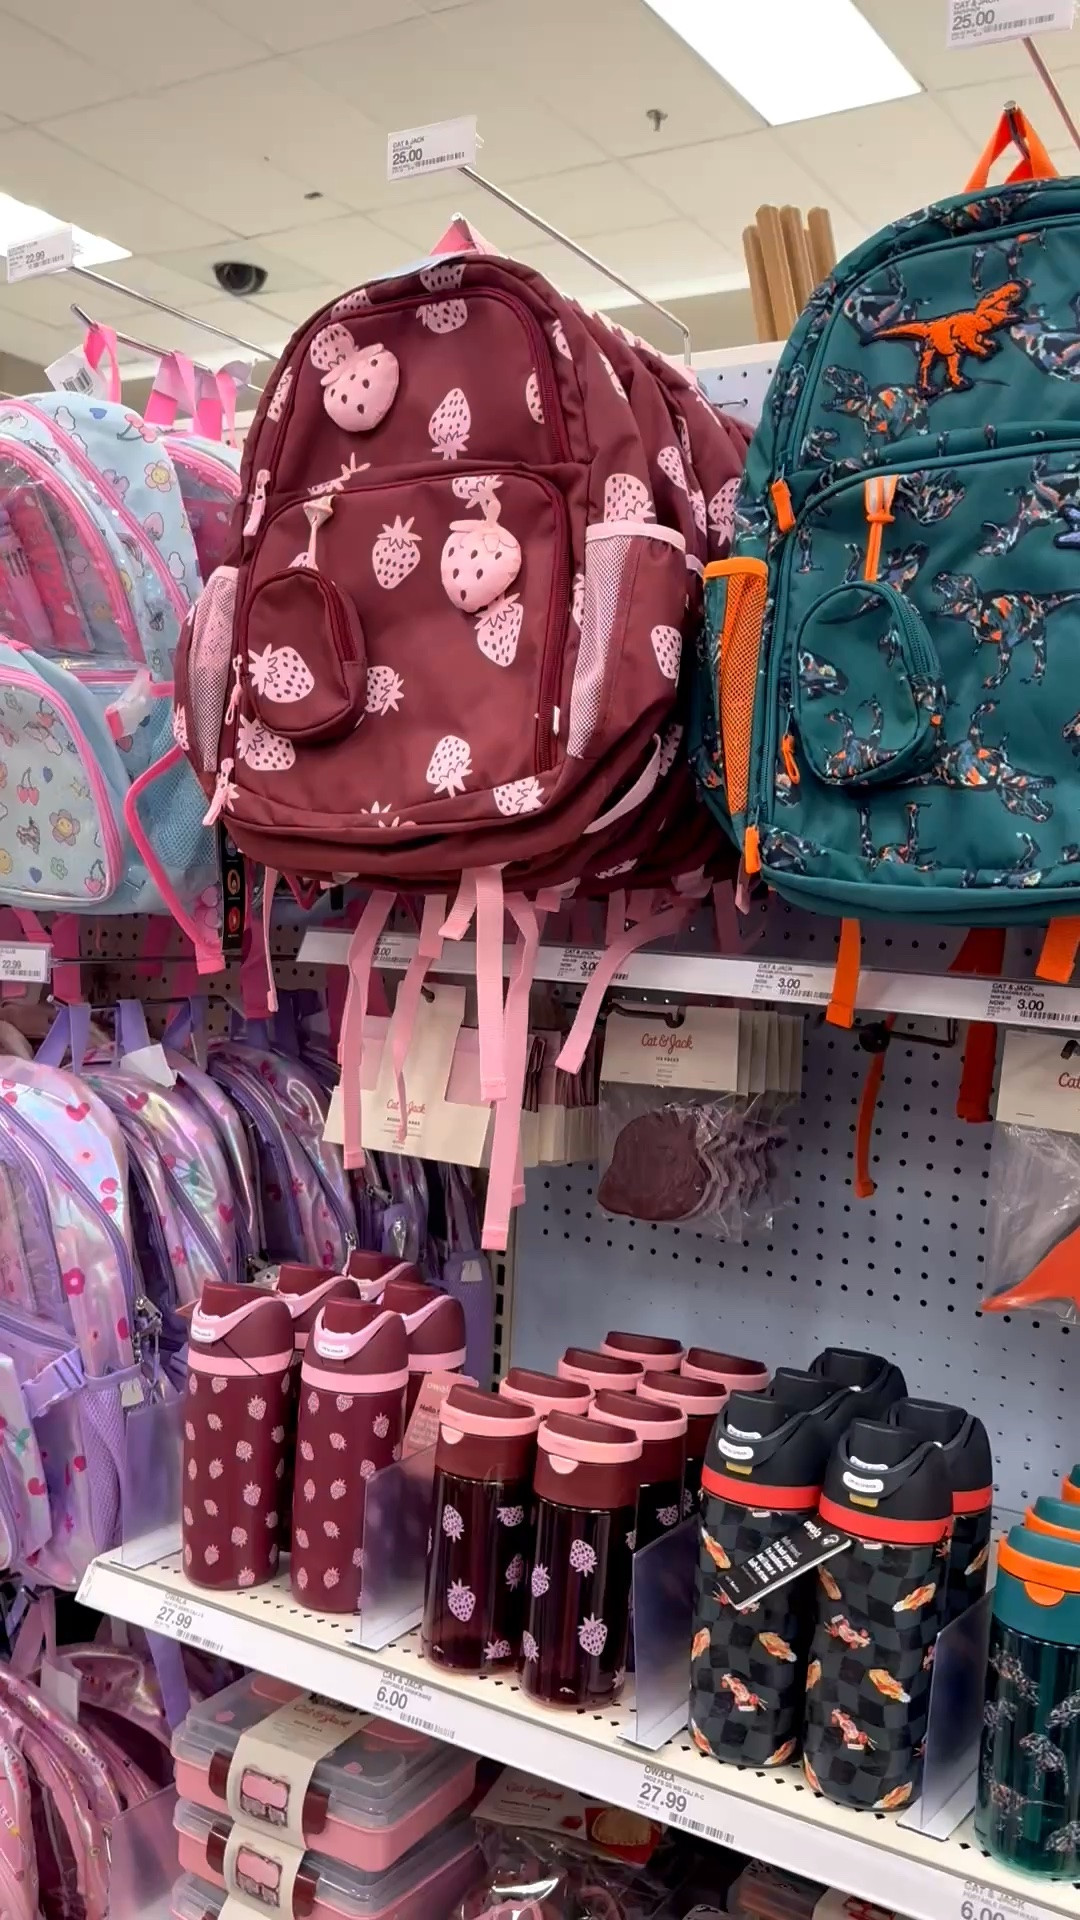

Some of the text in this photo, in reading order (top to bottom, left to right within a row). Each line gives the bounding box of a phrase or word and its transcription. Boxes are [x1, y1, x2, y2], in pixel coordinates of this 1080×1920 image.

[952, 9, 995, 31] 25.00
[393, 140, 404, 149] CAT
[411, 136, 425, 145] JACK
[393, 148, 423, 166] 25.00
[26, 250, 46, 265] 22.99
[2, 960, 22, 969] 22.99
[778, 977, 801, 989] 3.00
[1017, 998, 1045, 1011] 3.00
[641, 1033, 658, 1047] Cat
[667, 1034, 694, 1055] Jack
[803, 1520, 821, 1538] owala
[156, 1606, 192, 1629] 27.99
[382, 1671, 397, 1681] CAT
[403, 1678, 424, 1691] JACK
[376, 1686, 408, 1710] 6.00
[644, 1765, 675, 1783] OWALA
[639, 1782, 687, 1812] 27.99
